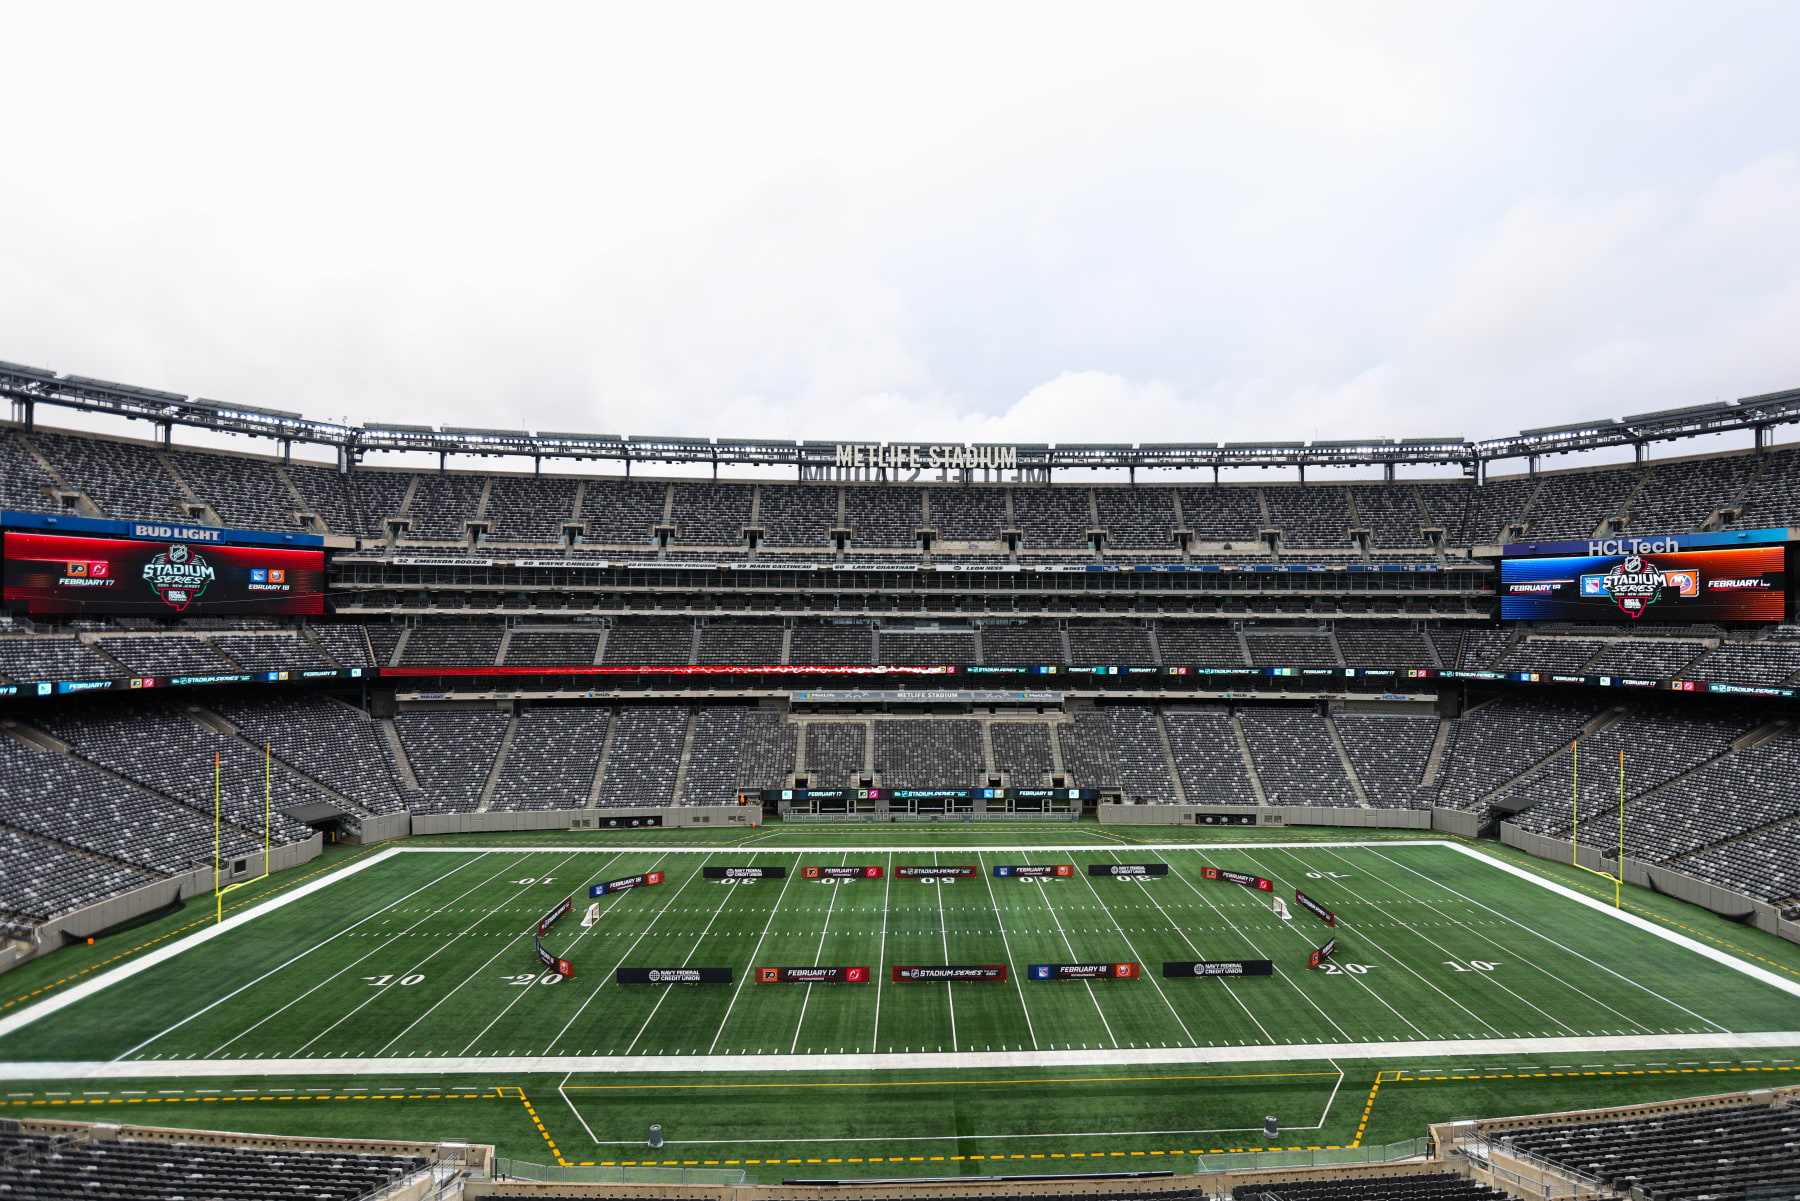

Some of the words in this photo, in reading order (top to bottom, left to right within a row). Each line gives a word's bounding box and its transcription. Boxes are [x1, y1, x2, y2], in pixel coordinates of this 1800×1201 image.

[836, 444, 921, 468] METLIFE
[929, 446, 1017, 469] STADIUM
[136, 525, 172, 538] BUD
[173, 528, 220, 541] LIGHT
[1588, 537, 1679, 556] HCLTech
[142, 564, 215, 580] STADIUM
[154, 576, 204, 584] SERIES
[1602, 574, 1668, 588] STADIUM
[1708, 579, 1759, 588] FEBRUARY
[1223, 872, 1247, 881] FEBRUARY
[610, 878, 635, 888] FEBRUARY
[1318, 963, 1368, 975] 20
[1442, 960, 1494, 972] 10
[368, 974, 426, 986] 10
[508, 974, 563, 985] 20
